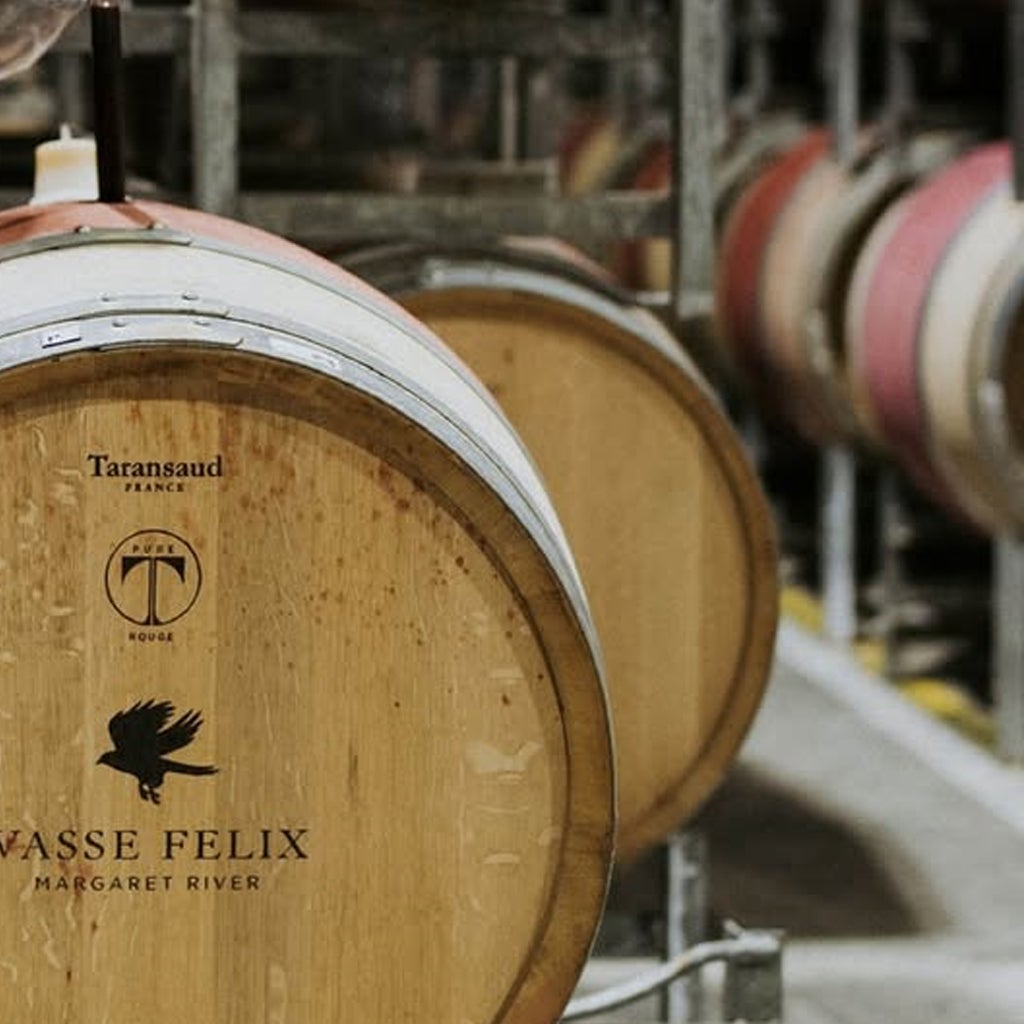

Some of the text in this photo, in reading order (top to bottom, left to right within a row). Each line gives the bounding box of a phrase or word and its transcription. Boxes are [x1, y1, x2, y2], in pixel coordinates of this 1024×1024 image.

[88, 454, 224, 478] Taransaud
[124, 483, 185, 493] FRANCE
[132, 544, 175, 554] PURE
[128, 632, 174, 643] ROUGE
[162, 829, 309, 861] FELIX
[34, 875, 261, 892] MARGARET RIVER
